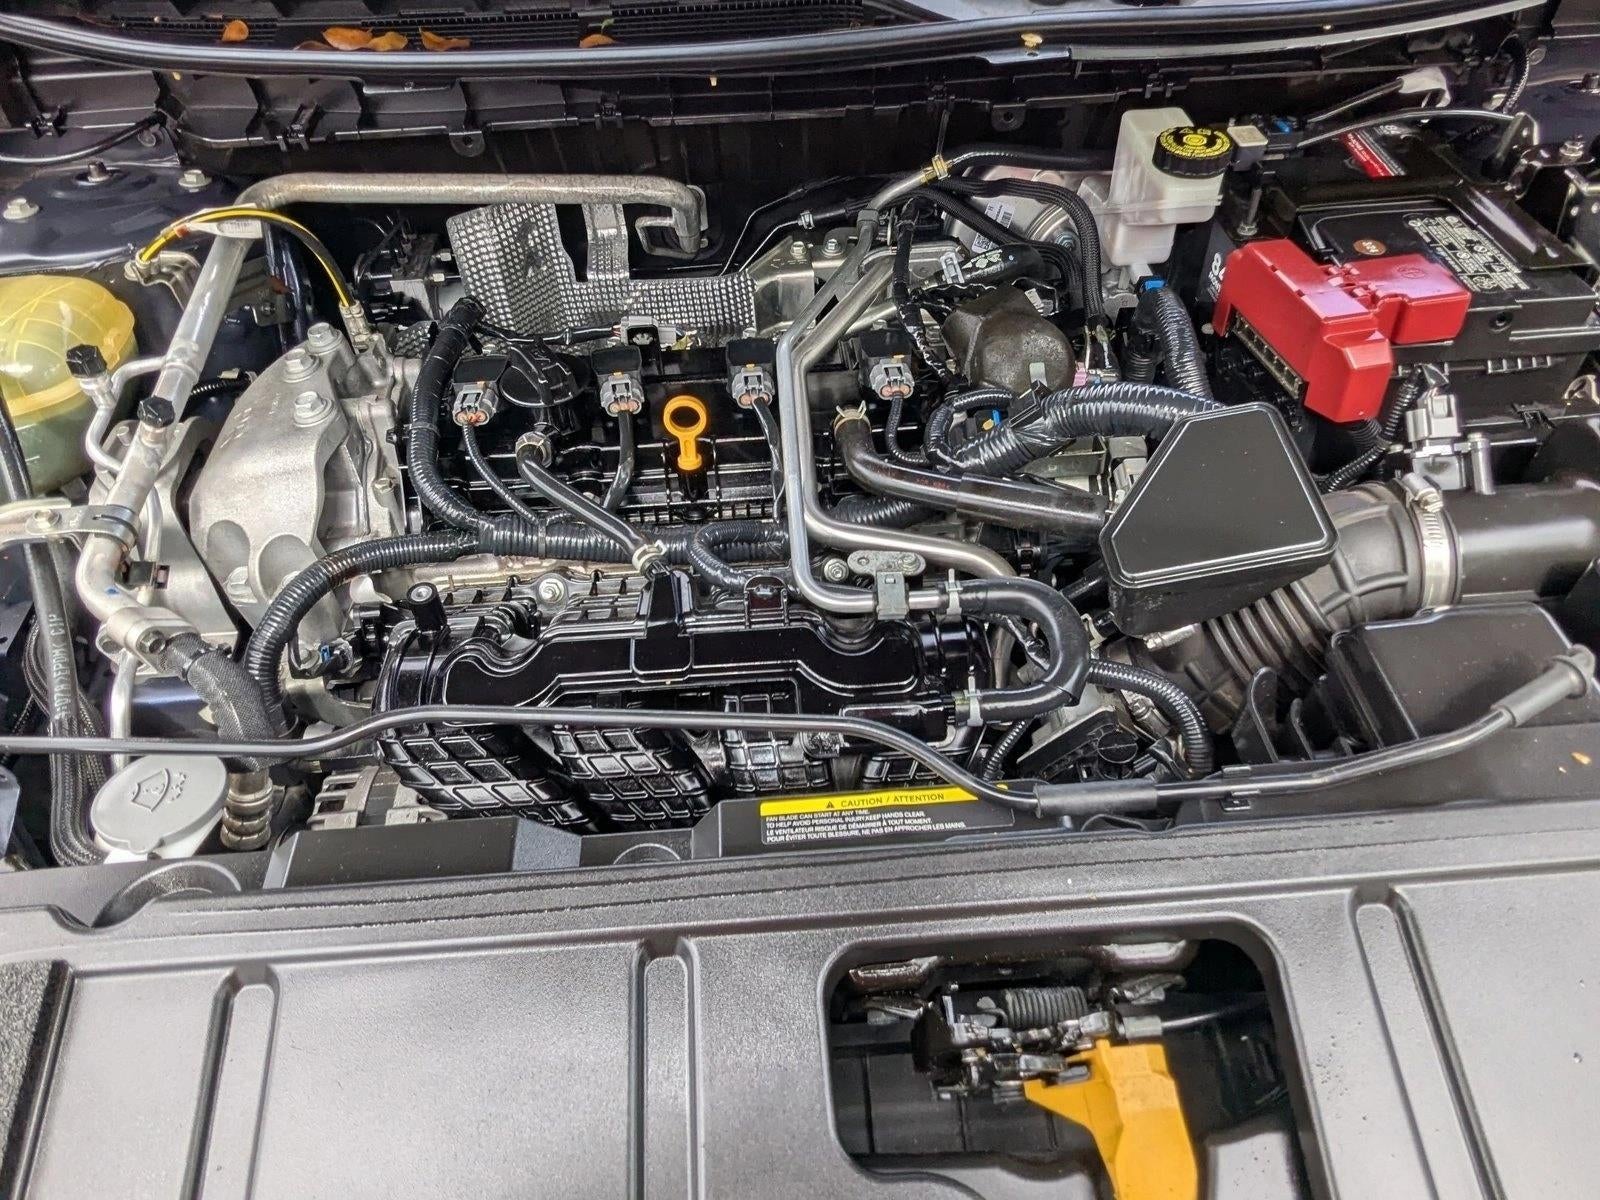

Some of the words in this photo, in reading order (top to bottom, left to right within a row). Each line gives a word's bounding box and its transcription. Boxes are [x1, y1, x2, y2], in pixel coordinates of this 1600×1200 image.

[840, 797, 883, 808] CAUTION
[893, 793, 945, 803] ATTENTION
[792, 819, 811, 827] AVOID
[811, 817, 844, 825] PERSONAL
[865, 813, 882, 821] KEEP
[882, 811, 904, 819] HANDS
[766, 835, 785, 843] POUR
[785, 833, 806, 841] ÉVITER
[806, 832, 827, 840] TOUTE
[893, 823, 932, 832] APPROCHER
[932, 823, 945, 831] LES
[775, 826, 814, 835] VENTILATEUR
[814, 824, 838, 832] RISQUE
[848, 820, 882, 829] DÉMARRER
